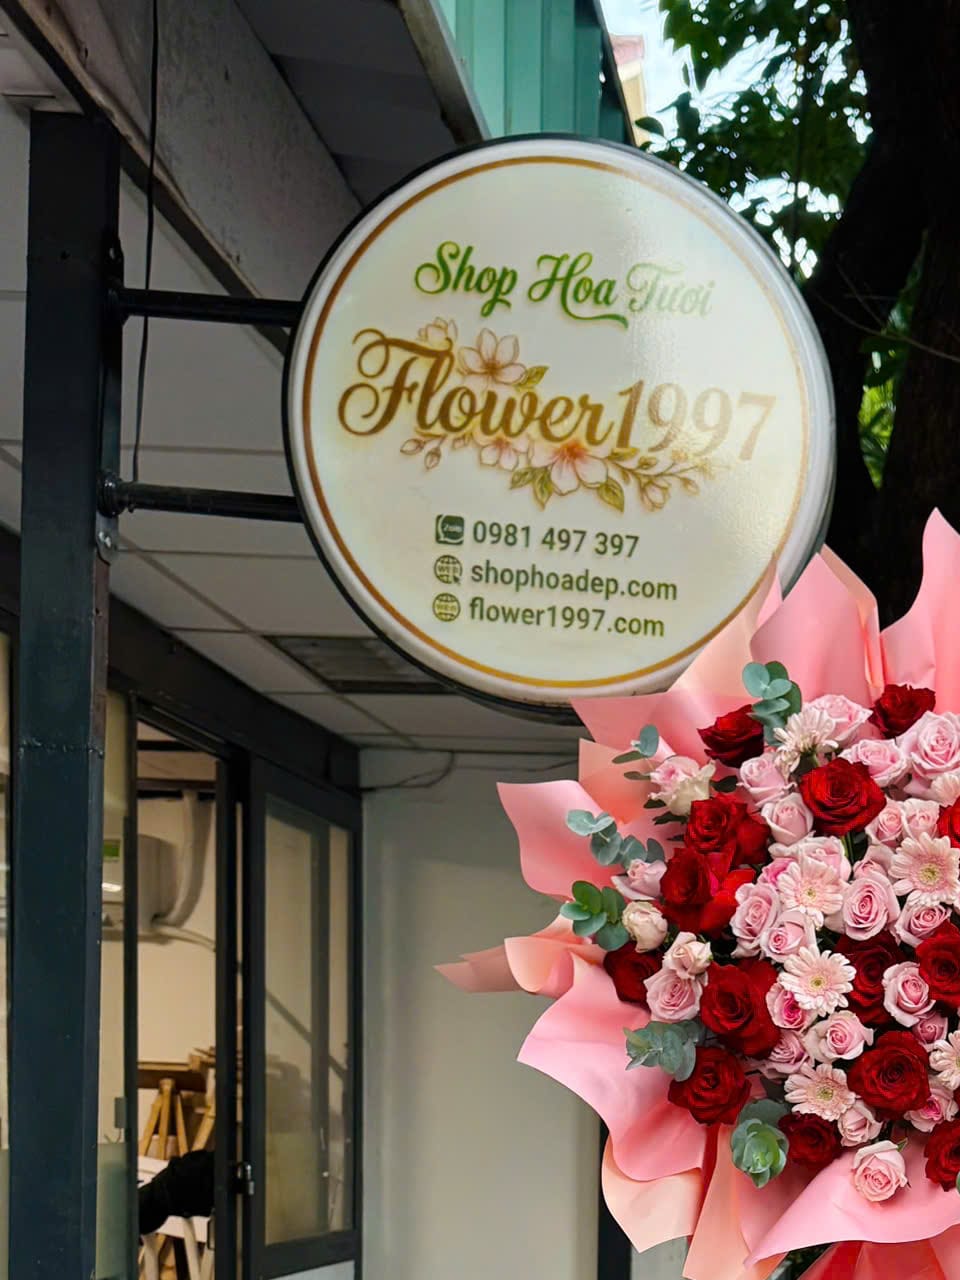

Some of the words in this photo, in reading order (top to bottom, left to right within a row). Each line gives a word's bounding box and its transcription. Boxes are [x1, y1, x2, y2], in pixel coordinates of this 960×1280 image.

[414, 241, 518, 317] Shop
[528, 252, 629, 330] Hoa
[473, 520, 531, 548] 0981
[541, 527, 587, 553] 497
[594, 532, 639, 558] 397
[471, 560, 678, 600] shophoadep.com
[470, 597, 665, 637] flower1997.com
